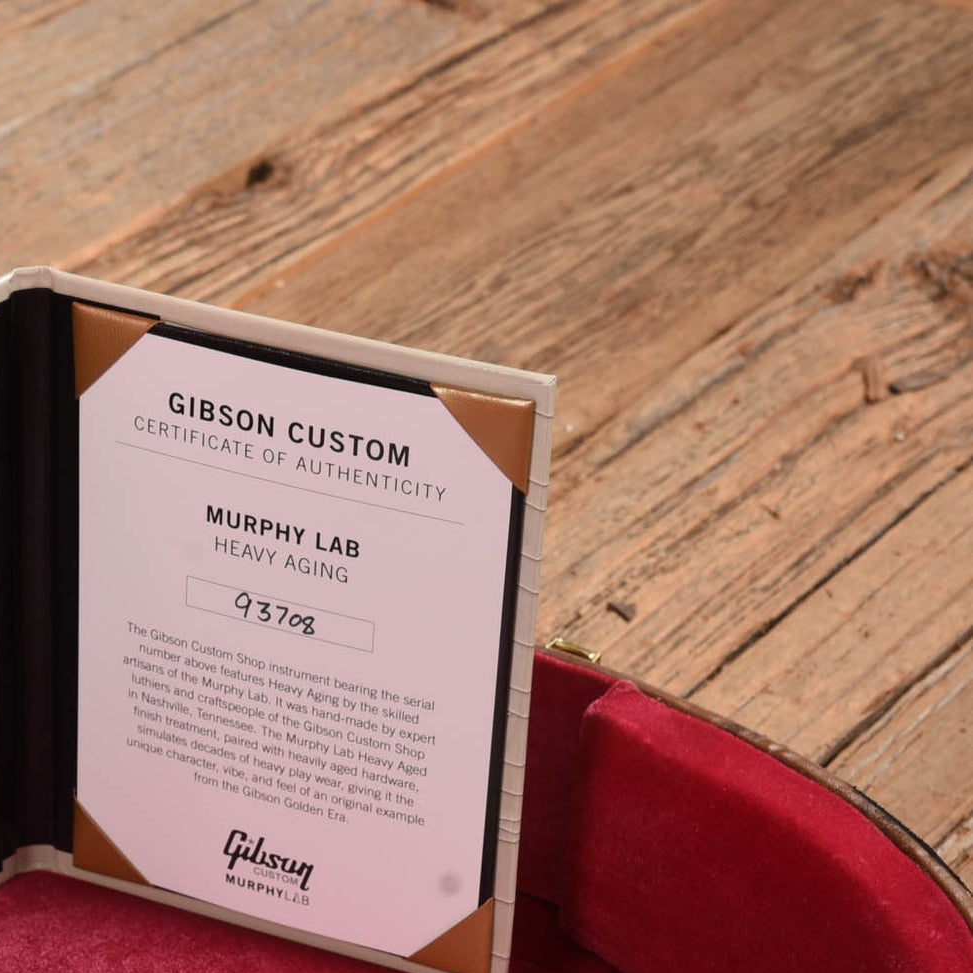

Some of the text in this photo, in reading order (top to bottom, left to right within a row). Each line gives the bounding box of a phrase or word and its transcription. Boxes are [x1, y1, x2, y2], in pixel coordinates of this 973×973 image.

[134, 415, 447, 502] CERTIFICATE OF AUTHENTICITY
[168, 391, 410, 468] GIBSON CUSTOM
[206, 504, 360, 559] MURPHY LAB
[215, 535, 348, 584] HEAVY AGING
[234, 592, 316, 635] 93708
[122, 655, 436, 746] artisans of the Murphy Lab. It was hand-made by expert
[127, 621, 435, 711] The Gibson Custom Shop instrument bearing the serial
[139, 644, 420, 725] number above features Heavy Aging by the skilled
[128, 690, 428, 777] in Nashville, Tennessee. The Murphy Lab Heavy Aged
[131, 673, 425, 761] luthiers and craftspeople of the Gibson Custom Shop
[133, 705, 419, 793] finish treatment, paired with heavily aged hardware,
[126, 738, 425, 826] unique character, vibe, and feel of an original example
[137, 725, 414, 807] simulates decades of heavy play wear, giving it the
[194, 771, 348, 824] from the Gibson Golden Era.
[223, 829, 314, 891] Gibson
[253, 866, 298, 886] CUSTOM
